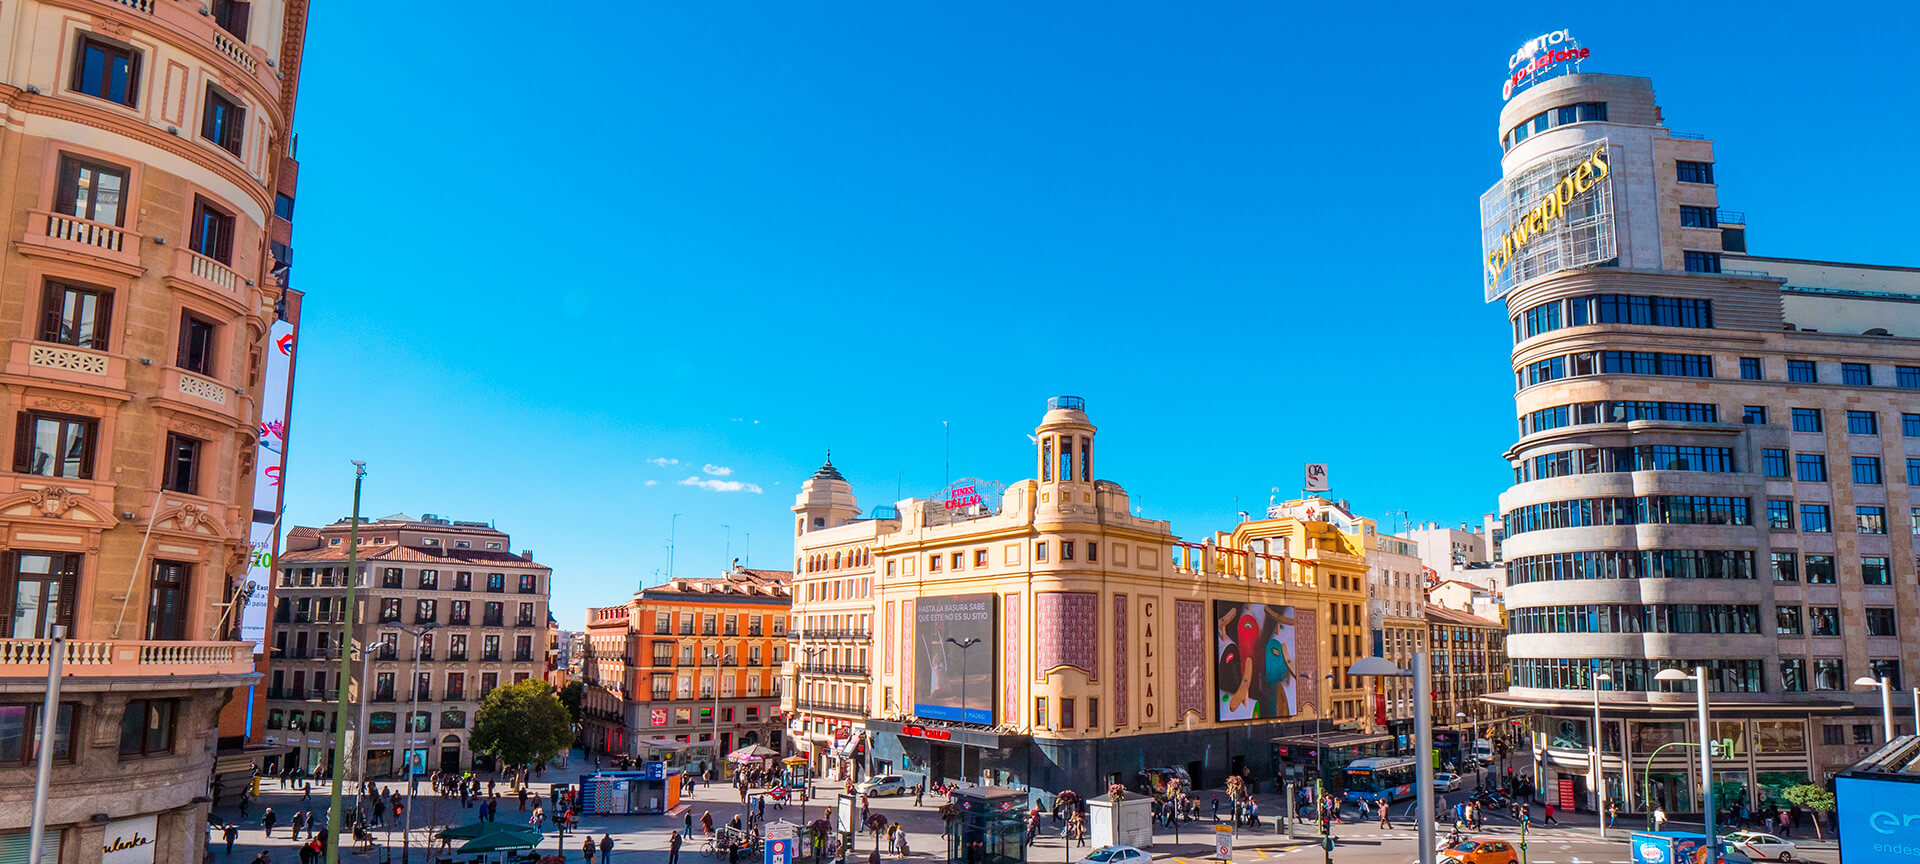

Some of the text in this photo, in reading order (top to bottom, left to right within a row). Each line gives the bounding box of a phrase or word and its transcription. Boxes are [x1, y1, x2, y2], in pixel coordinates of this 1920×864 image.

[1509, 29, 1575, 69] CAPITOL
[1512, 48, 1590, 86] vodafone
[1488, 145, 1609, 291] Schweppes
[945, 494, 981, 510] CALLAO
[952, 486, 974, 497] CINES
[918, 602, 985, 613] HASTA LA BASURA SABE
[918, 612, 988, 622] QUE ESTE NO ES SU SITIO
[1145, 603, 1154, 718] CALLAO
